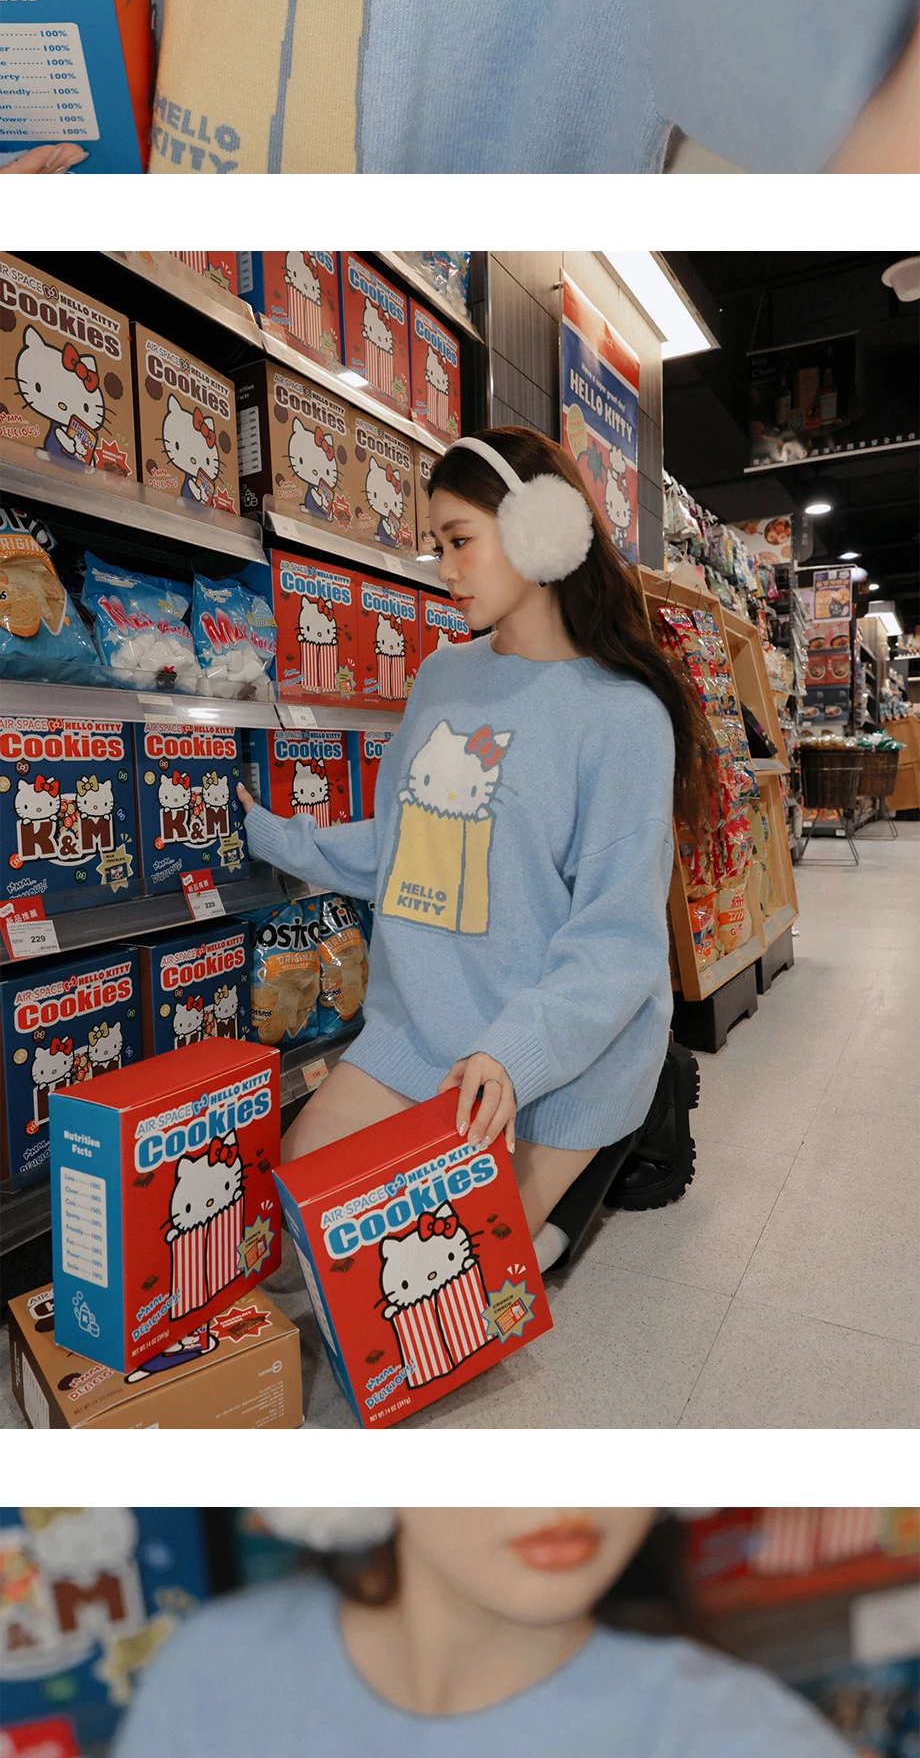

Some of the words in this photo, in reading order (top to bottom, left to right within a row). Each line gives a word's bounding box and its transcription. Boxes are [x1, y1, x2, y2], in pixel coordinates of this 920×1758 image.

[156, 95, 241, 152] HELLO
[0, 280, 120, 358] Cookies
[10, 267, 43, 294] SPACE
[60, 294, 91, 319] HELLO
[92, 309, 119, 332] KITTY
[147, 359, 230, 419] Cookies
[569, 369, 603, 415] HELLO
[604, 401, 633, 443] KITTY
[282, 572, 351, 602] Cookies
[1, 733, 123, 760] Cookies
[16, 720, 47, 731] SPACE
[65, 721, 92, 732] HELLO
[94, 722, 122, 732] KITTY
[397, 895, 446, 916] KITTY
[400, 880, 448, 903] HELLO
[30, 935, 46, 943] 229
[17, 979, 133, 1030] Cookies
[137, 1119, 157, 1136] AIR
[158, 1104, 192, 1128] SPACE
[211, 1086, 241, 1105] HELLO
[242, 1071, 270, 1092] KITTY
[63, 1130, 100, 1148] Nutrition
[72, 1144, 92, 1158] Facts
[138, 1092, 270, 1169] Cookies
[407, 1159, 447, 1186] HELLO
[448, 1143, 485, 1165] KITT
[328, 1157, 497, 1256] Cookies
